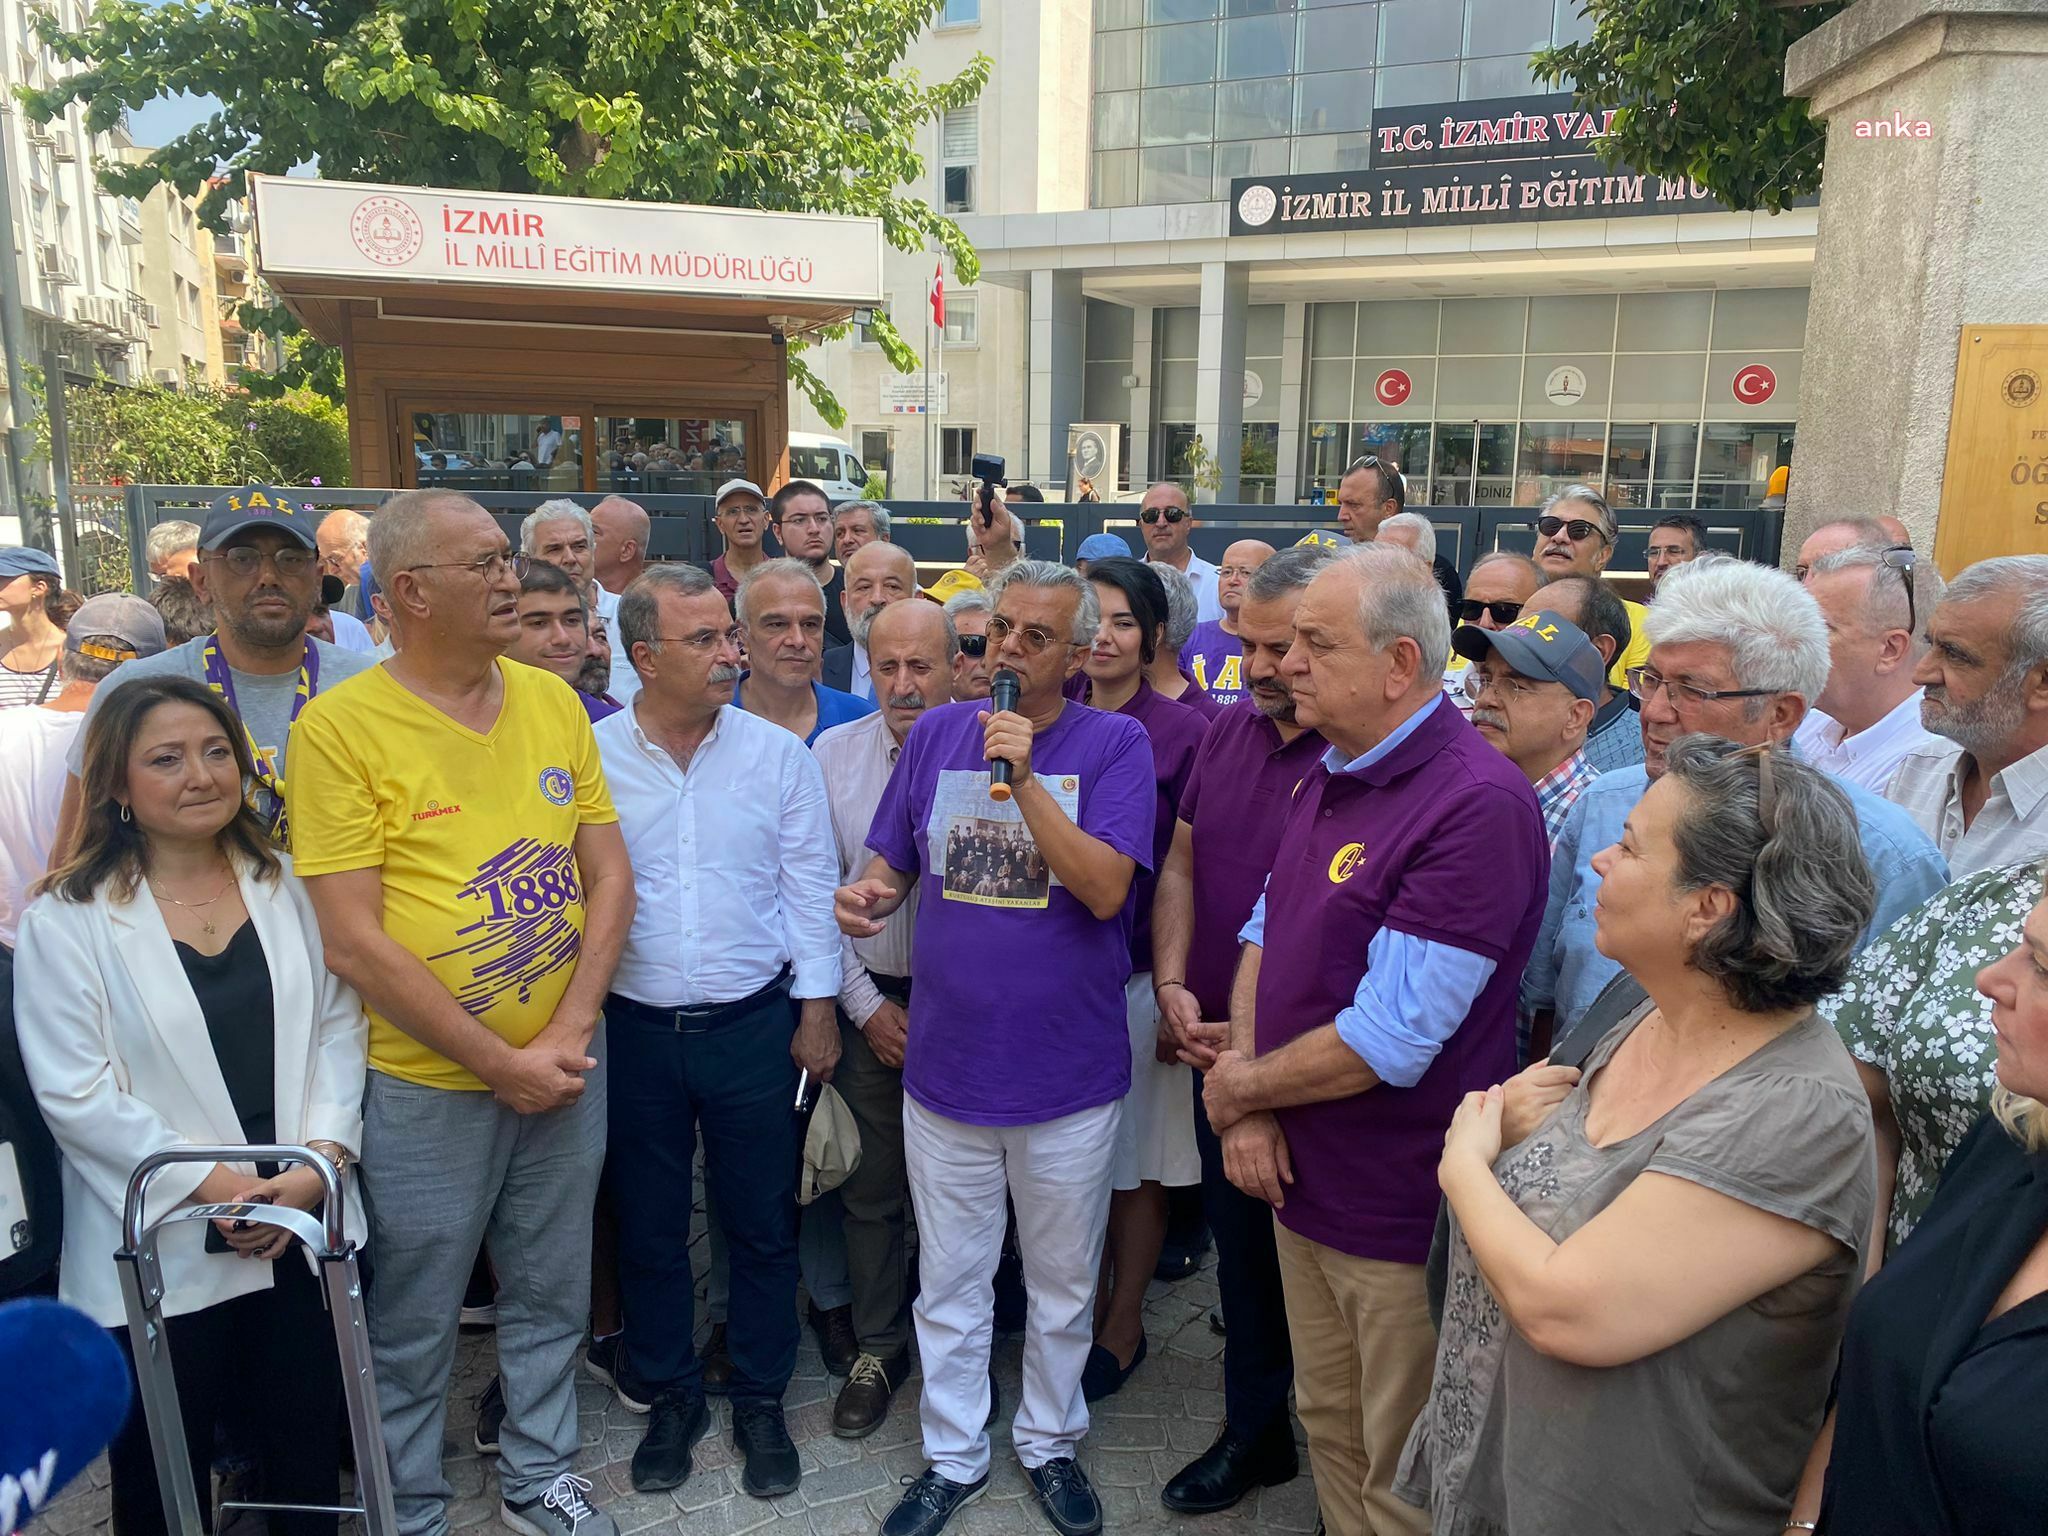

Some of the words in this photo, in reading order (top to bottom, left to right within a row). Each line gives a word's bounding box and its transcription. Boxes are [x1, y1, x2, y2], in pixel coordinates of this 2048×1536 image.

[1378, 123, 1433, 153] T.C.
[1439, 110, 1550, 149] İZMİR
[1280, 182, 1372, 221] İZMİR
[1380, 179, 1412, 215] İL
[1421, 173, 1512, 213] MİLLÎ
[443, 203, 545, 238] İZMİR
[445, 238, 468, 266] İL
[476, 240, 546, 270] MİLLÎ
[554, 244, 642, 275] EĞİTİM
[650, 250, 813, 283] MÜDÜRLÜĞÜ
[2010, 456, 2048, 486] ÖĞ
[227, 491, 294, 516] İAL
[2034, 501, 2048, 525] S
[1192, 653, 1243, 691] İA
[477, 862, 580, 924] 1888
